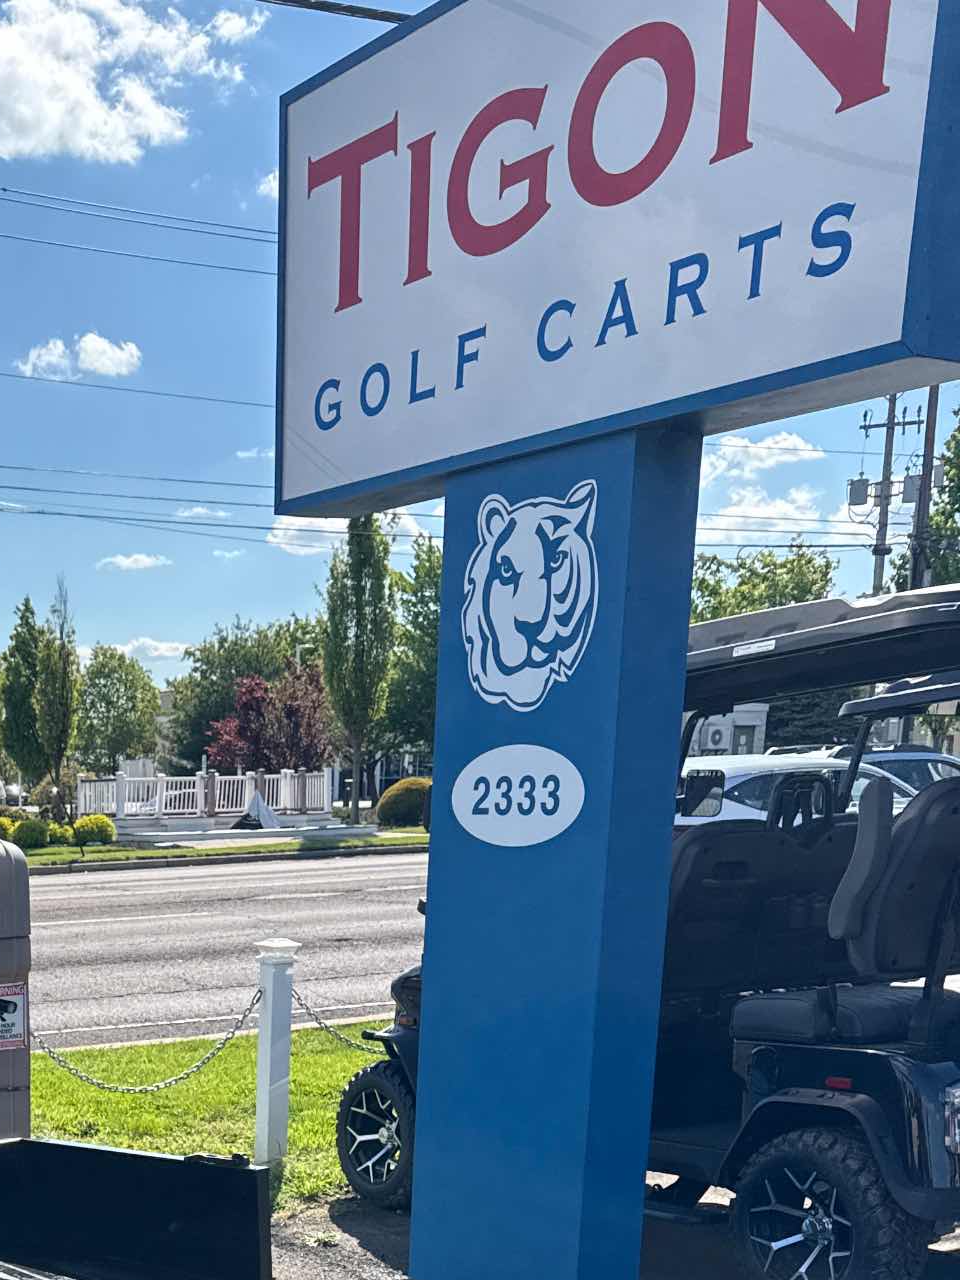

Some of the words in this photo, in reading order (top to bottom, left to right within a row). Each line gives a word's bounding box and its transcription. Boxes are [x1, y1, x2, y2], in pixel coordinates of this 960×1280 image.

[307, 0, 890, 313] TIGON
[314, 323, 487, 431] GOLF
[536, 201, 856, 362] CARTS
[472, 774, 560, 816] 2333
